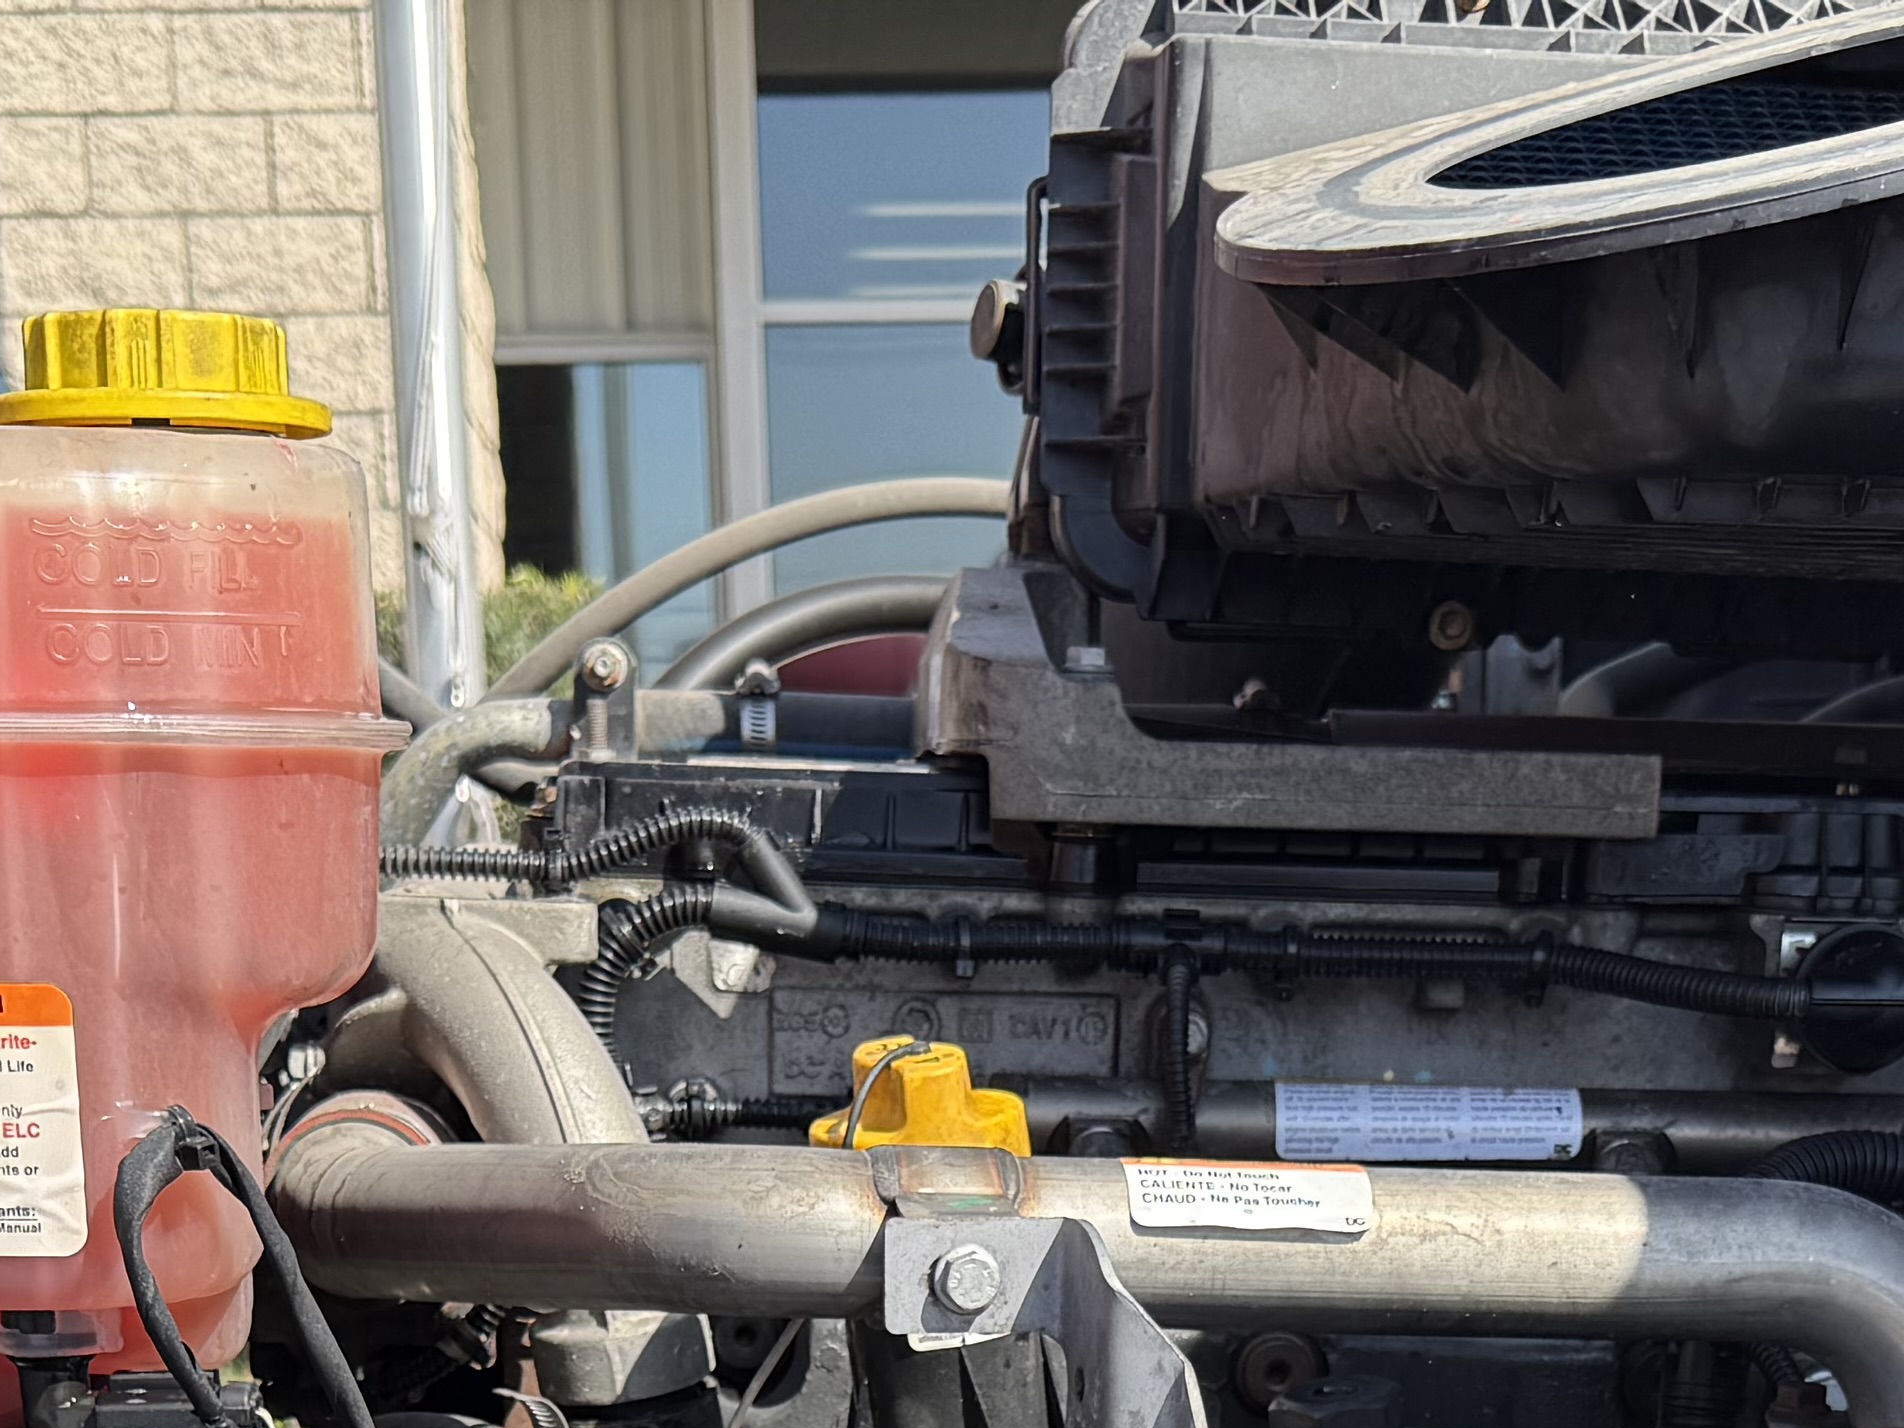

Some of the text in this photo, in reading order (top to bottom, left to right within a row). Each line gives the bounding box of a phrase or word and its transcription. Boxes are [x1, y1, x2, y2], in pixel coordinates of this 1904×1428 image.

[34, 543, 162, 588] COLD
[46, 623, 170, 667] COLD
[8, 1060, 34, 1073] Life
[3, 1122, 40, 1139] ELC
[24, 1165, 39, 1176] or
[1140, 1179, 1291, 1194] CALIENTE No Tocar
[1142, 1192, 1196, 1206] CHAUD
[1263, 1196, 1320, 1209] Toucher
